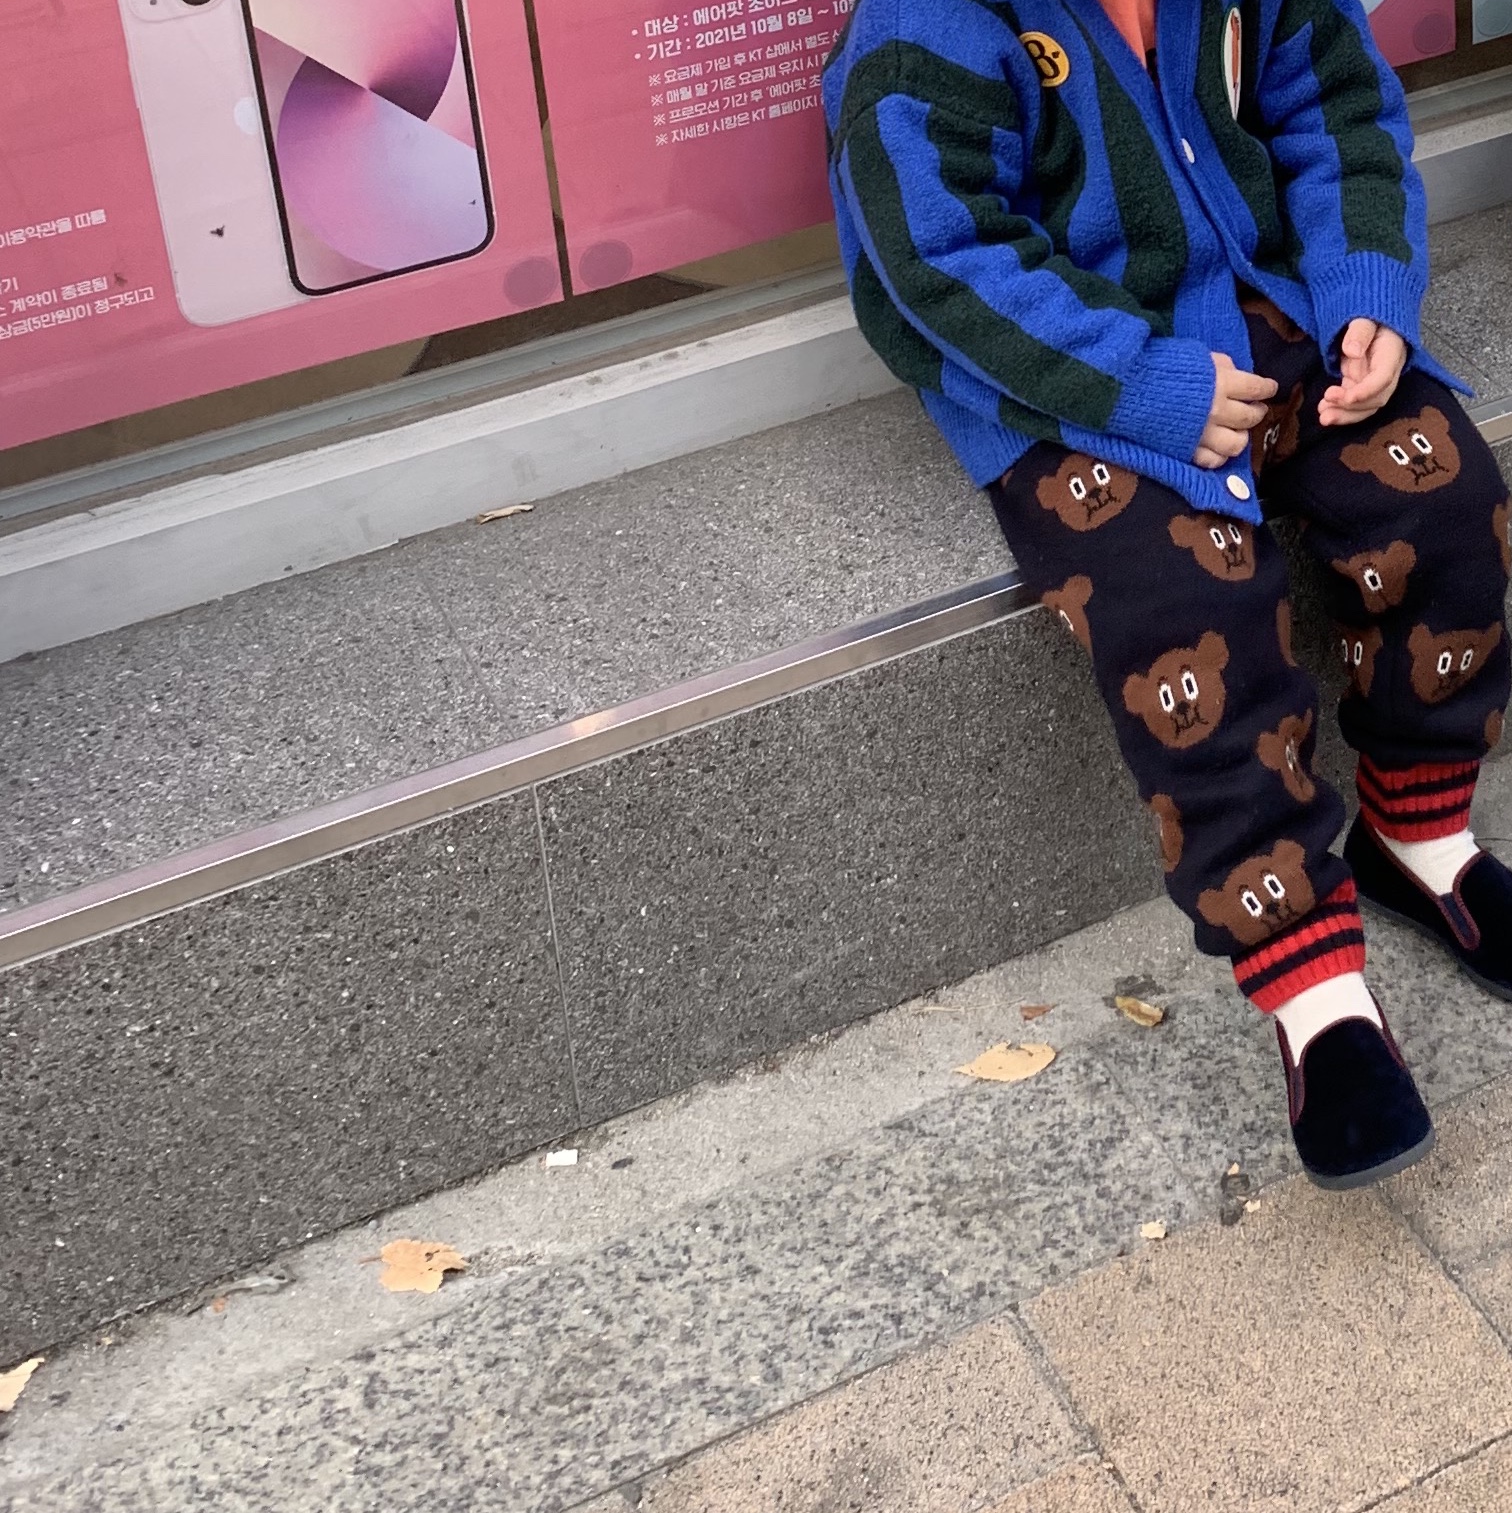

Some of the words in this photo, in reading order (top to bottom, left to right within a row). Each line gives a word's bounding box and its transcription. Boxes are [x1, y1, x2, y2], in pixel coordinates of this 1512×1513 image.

[644, 14, 680, 38] 대상
[692, 0, 745, 27] 에어팟
[647, 38, 682, 62] 기간
[695, 23, 748, 49] 2021년
[750, 14, 784, 35] 10월
[787, 7, 814, 26] 8일
[663, 63, 704, 85] 요금제
[705, 56, 731, 74] 가입
[734, 51, 748, 67] 후
[749, 48, 764, 63] KT
[805, 31, 830, 50] 별도
[666, 86, 693, 104] 매월
[695, 82, 709, 97] 말
[711, 76, 737, 92] 기준
[739, 65, 777, 87] 요금제
[778, 56, 804, 75] 유지
[805, 53, 820, 69] 시
[668, 99, 721, 124] 프로모션
[722, 94, 749, 111] 기간
[750, 88, 765, 102] 후
[671, 122, 710, 144] 자세한
[751, 108, 766, 122] KT
[768, 95, 819, 119] 홈페이지
[74, 208, 107, 229] 따름
[9, 289, 58, 314] 계약이
[60, 275, 108, 301] 종료됨
[94, 286, 155, 314] 청구되고
